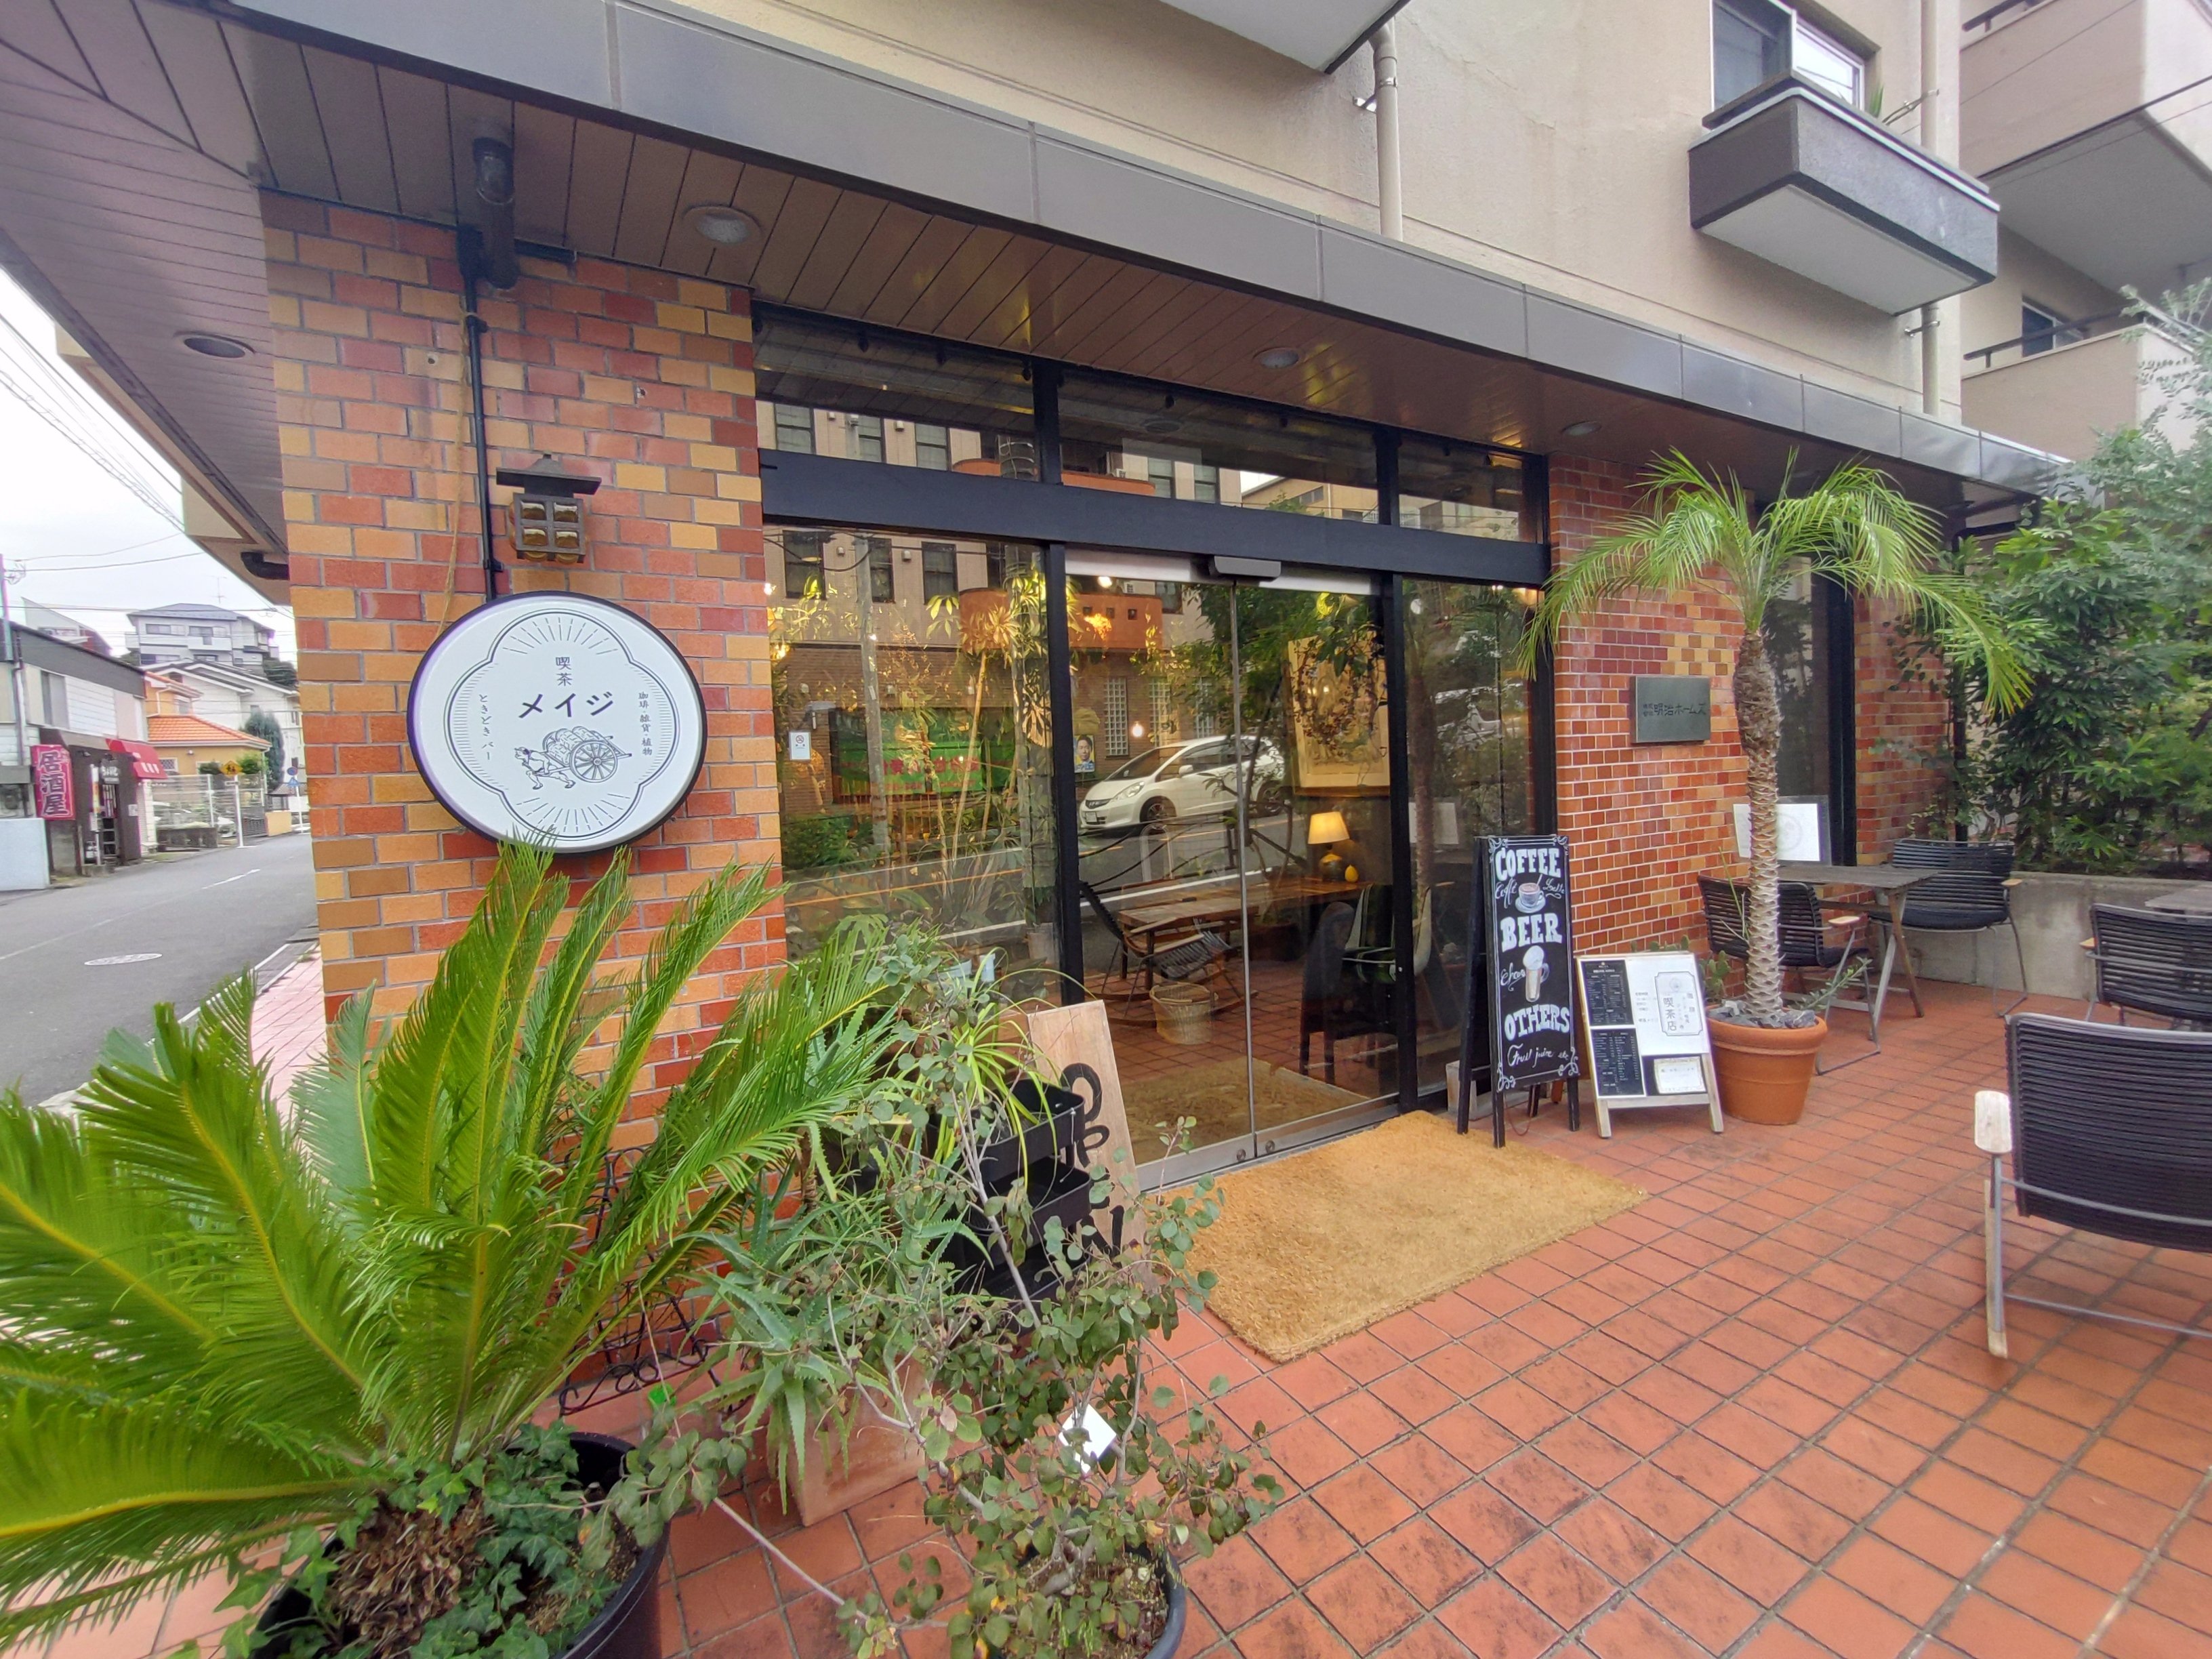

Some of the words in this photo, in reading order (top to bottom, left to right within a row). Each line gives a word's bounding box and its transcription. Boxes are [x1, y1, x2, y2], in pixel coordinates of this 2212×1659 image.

[555, 656, 573, 687] 喫茶
[518, 691, 614, 719] メイジ
[37, 749, 70, 817] 居酒屋
[1495, 847, 1561, 881] COFFEE
[1500, 913, 1563, 952] BEER
[1504, 1004, 1570, 1041] OTHERS
[1663, 997, 1677, 1031] 喫茶店
